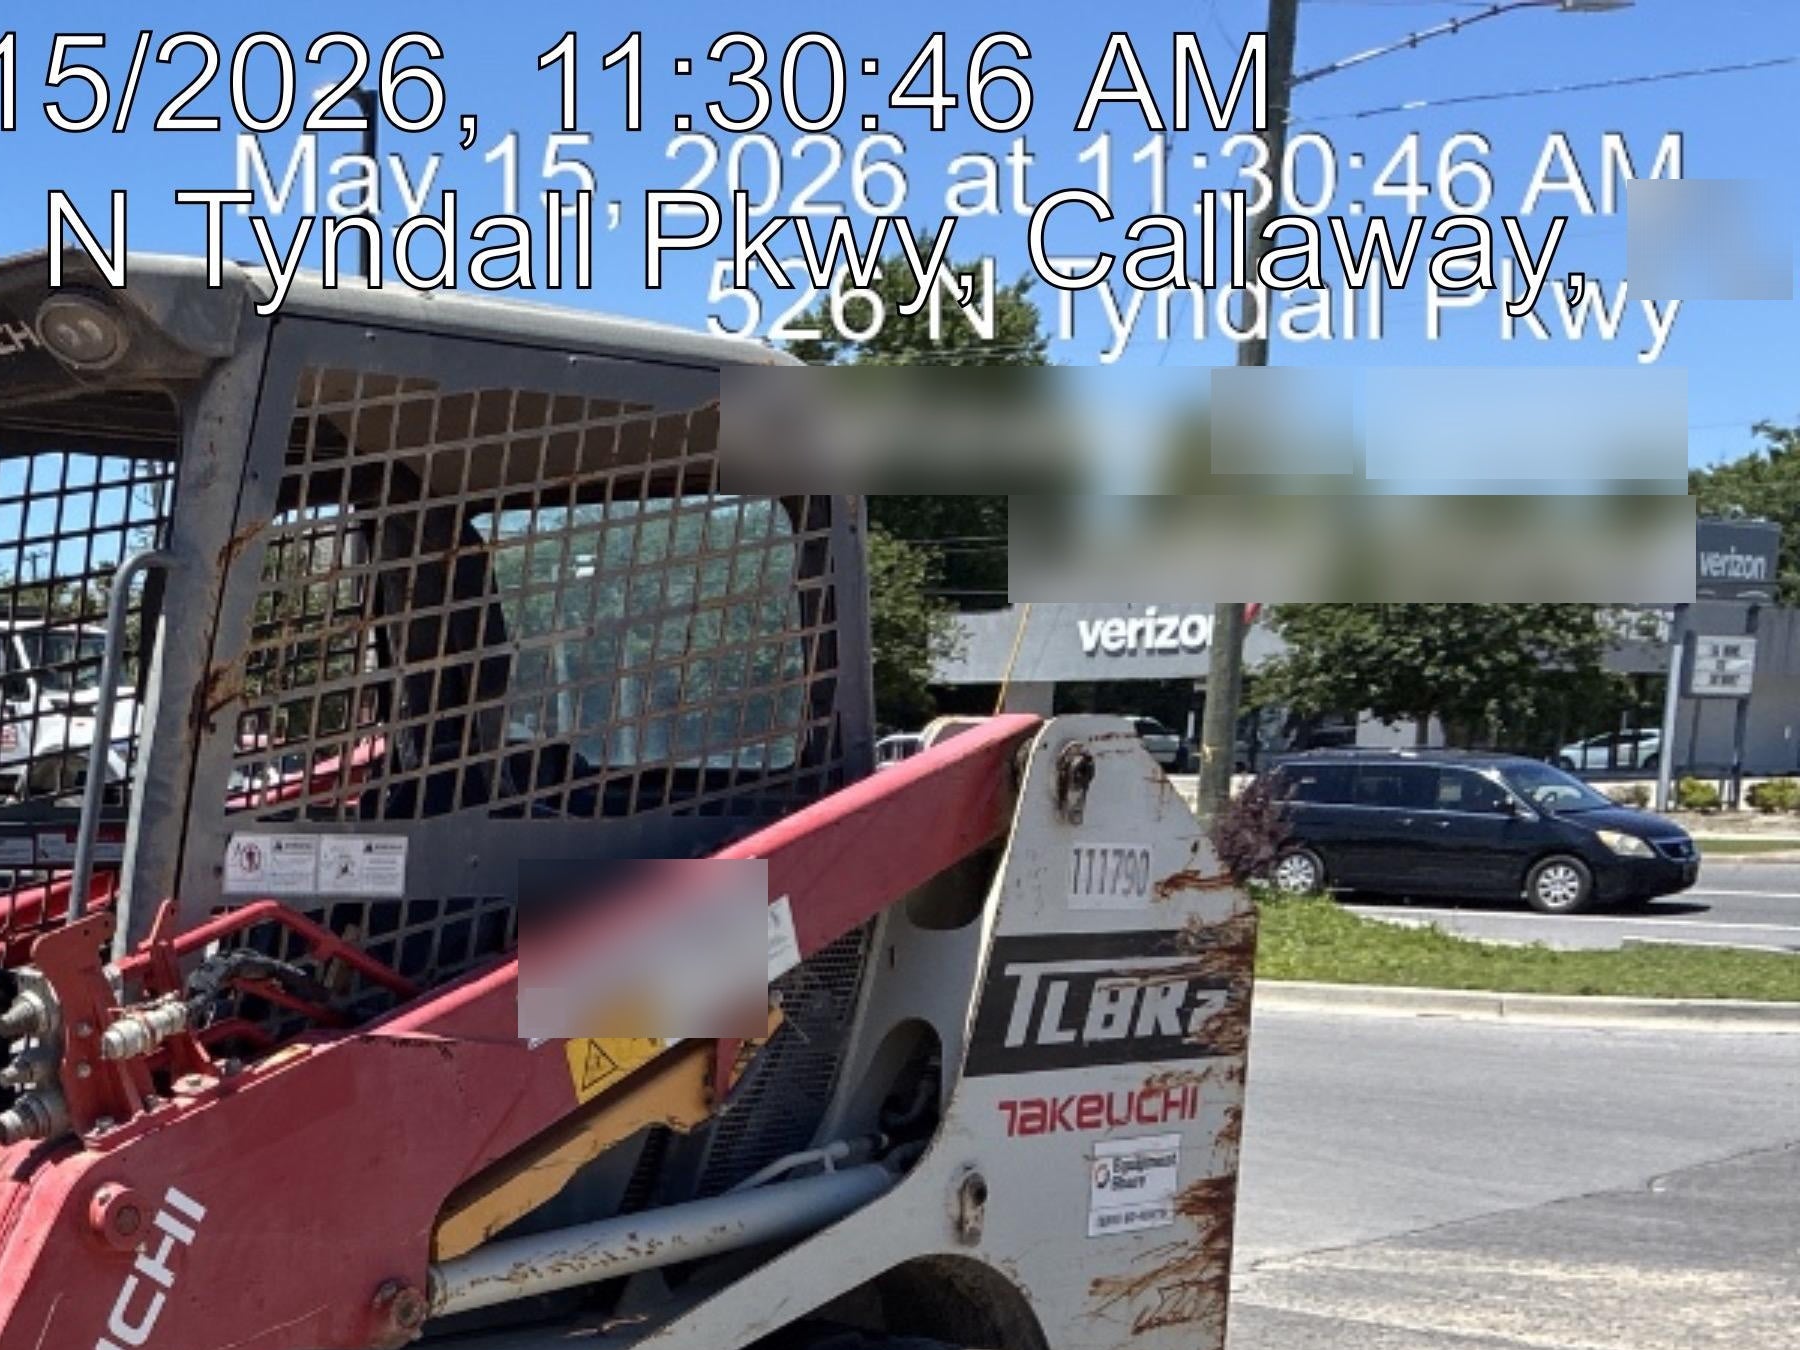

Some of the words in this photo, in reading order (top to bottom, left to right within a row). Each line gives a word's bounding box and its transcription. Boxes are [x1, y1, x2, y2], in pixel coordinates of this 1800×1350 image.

[1701, 545, 1766, 579] verizon
[1077, 605, 1215, 652] verizo
[1072, 848, 1150, 897] 111790
